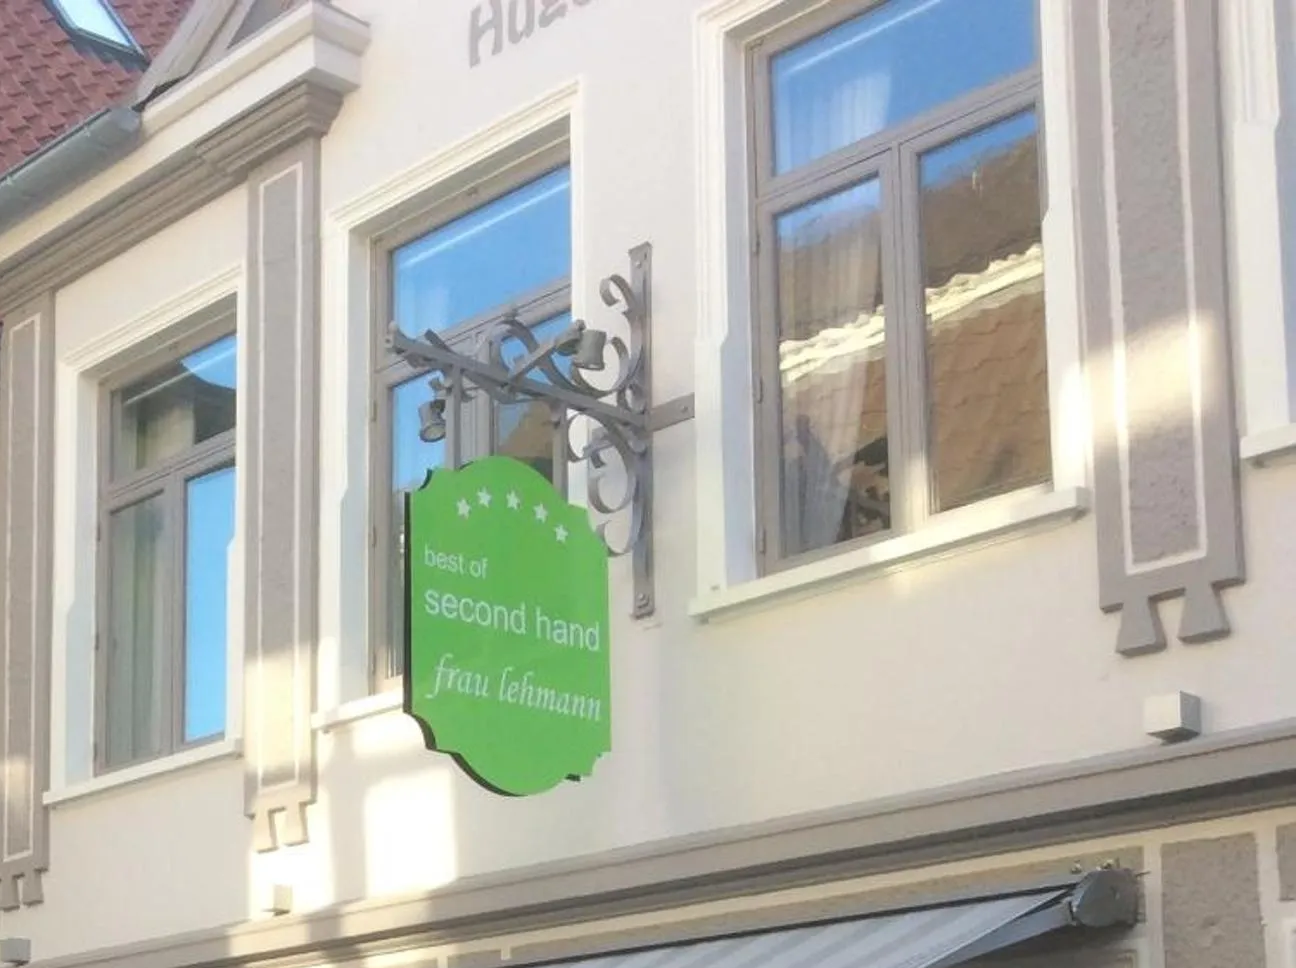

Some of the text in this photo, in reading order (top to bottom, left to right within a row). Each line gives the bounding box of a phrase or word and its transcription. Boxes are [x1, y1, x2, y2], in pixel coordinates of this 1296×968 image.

[423, 544, 489, 579] best of
[423, 588, 600, 652] second hand
[424, 653, 602, 722] frau lehmann
